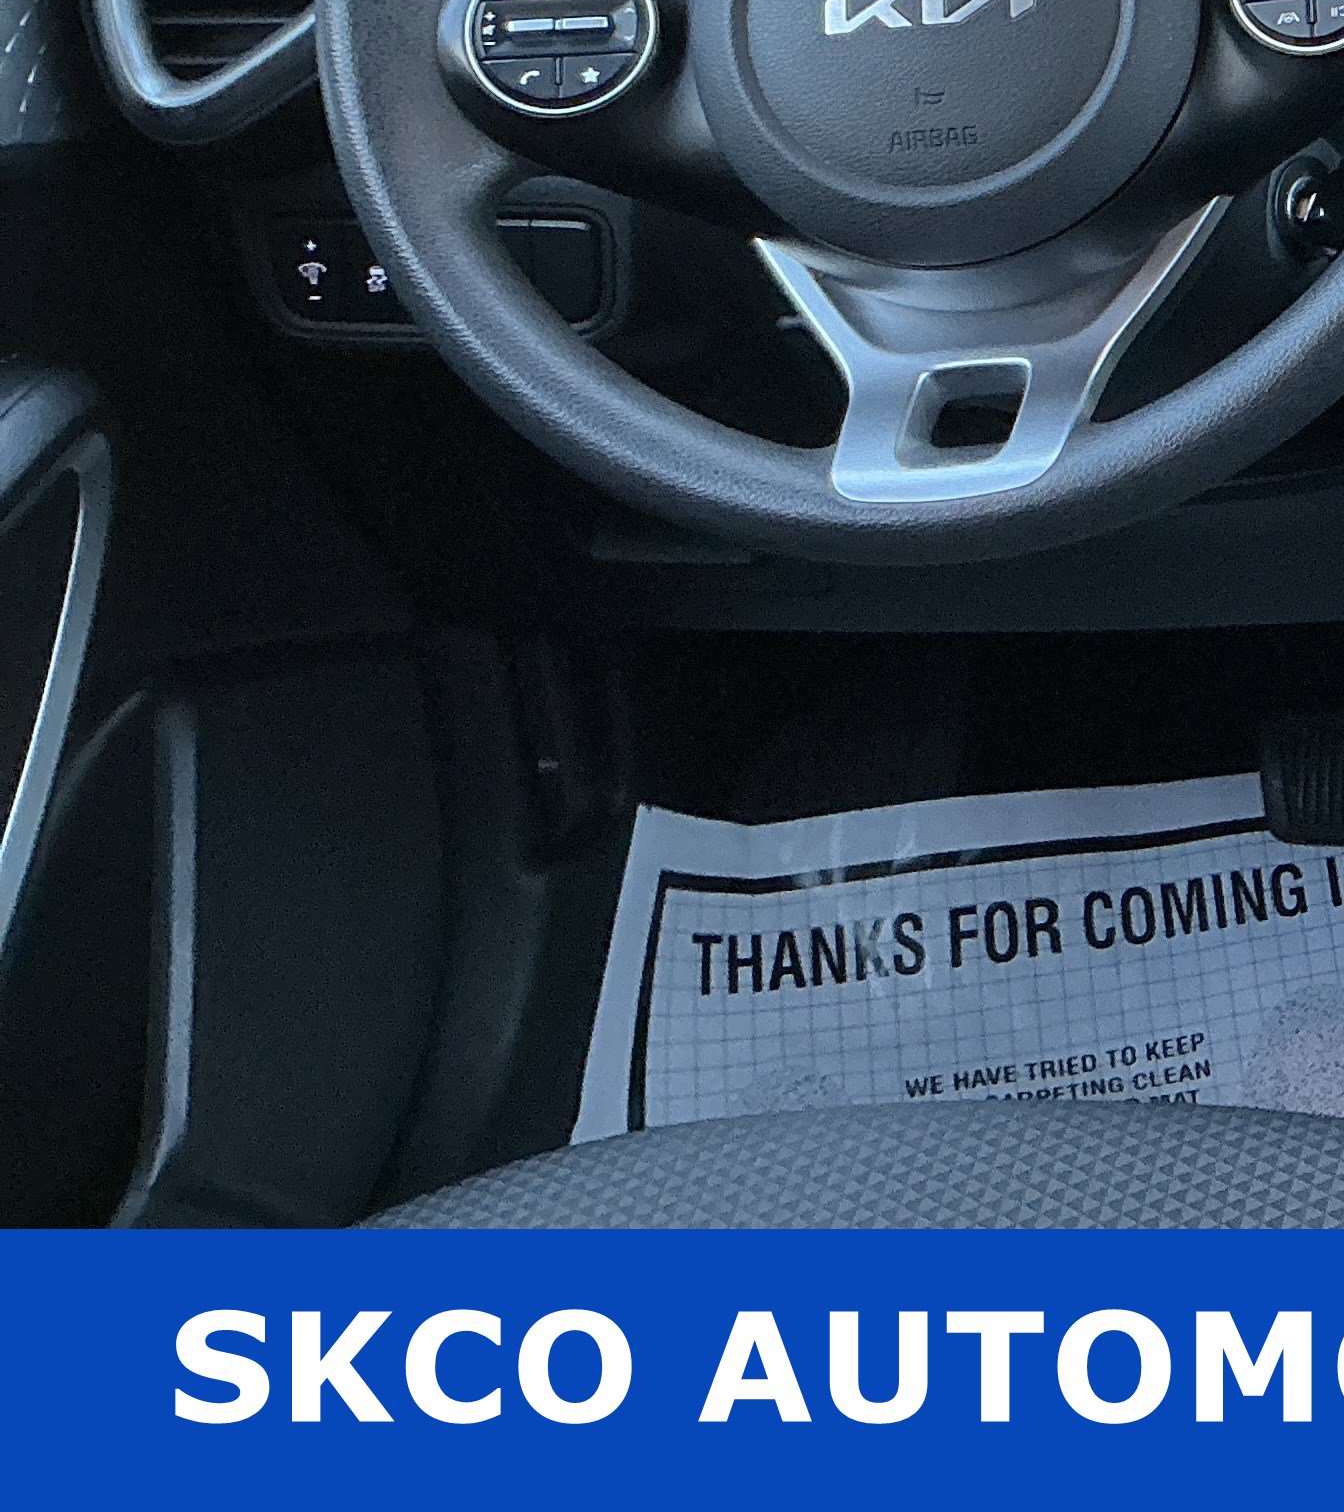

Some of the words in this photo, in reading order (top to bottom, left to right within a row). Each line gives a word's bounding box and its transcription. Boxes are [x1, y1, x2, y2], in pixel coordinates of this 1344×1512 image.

[888, 125, 980, 153] AIRBAG
[692, 912, 926, 996] THANKS
[949, 897, 1063, 968] FOR
[1083, 862, 1308, 950] COMING
[904, 1073, 945, 1098] WE
[952, 1062, 1018, 1092] HAVE
[1024, 1053, 1098, 1082] TRIED
[1105, 1045, 1137, 1069] TO
[1144, 1032, 1206, 1061] KEEP
[1131, 1059, 1212, 1091] CLEAN
